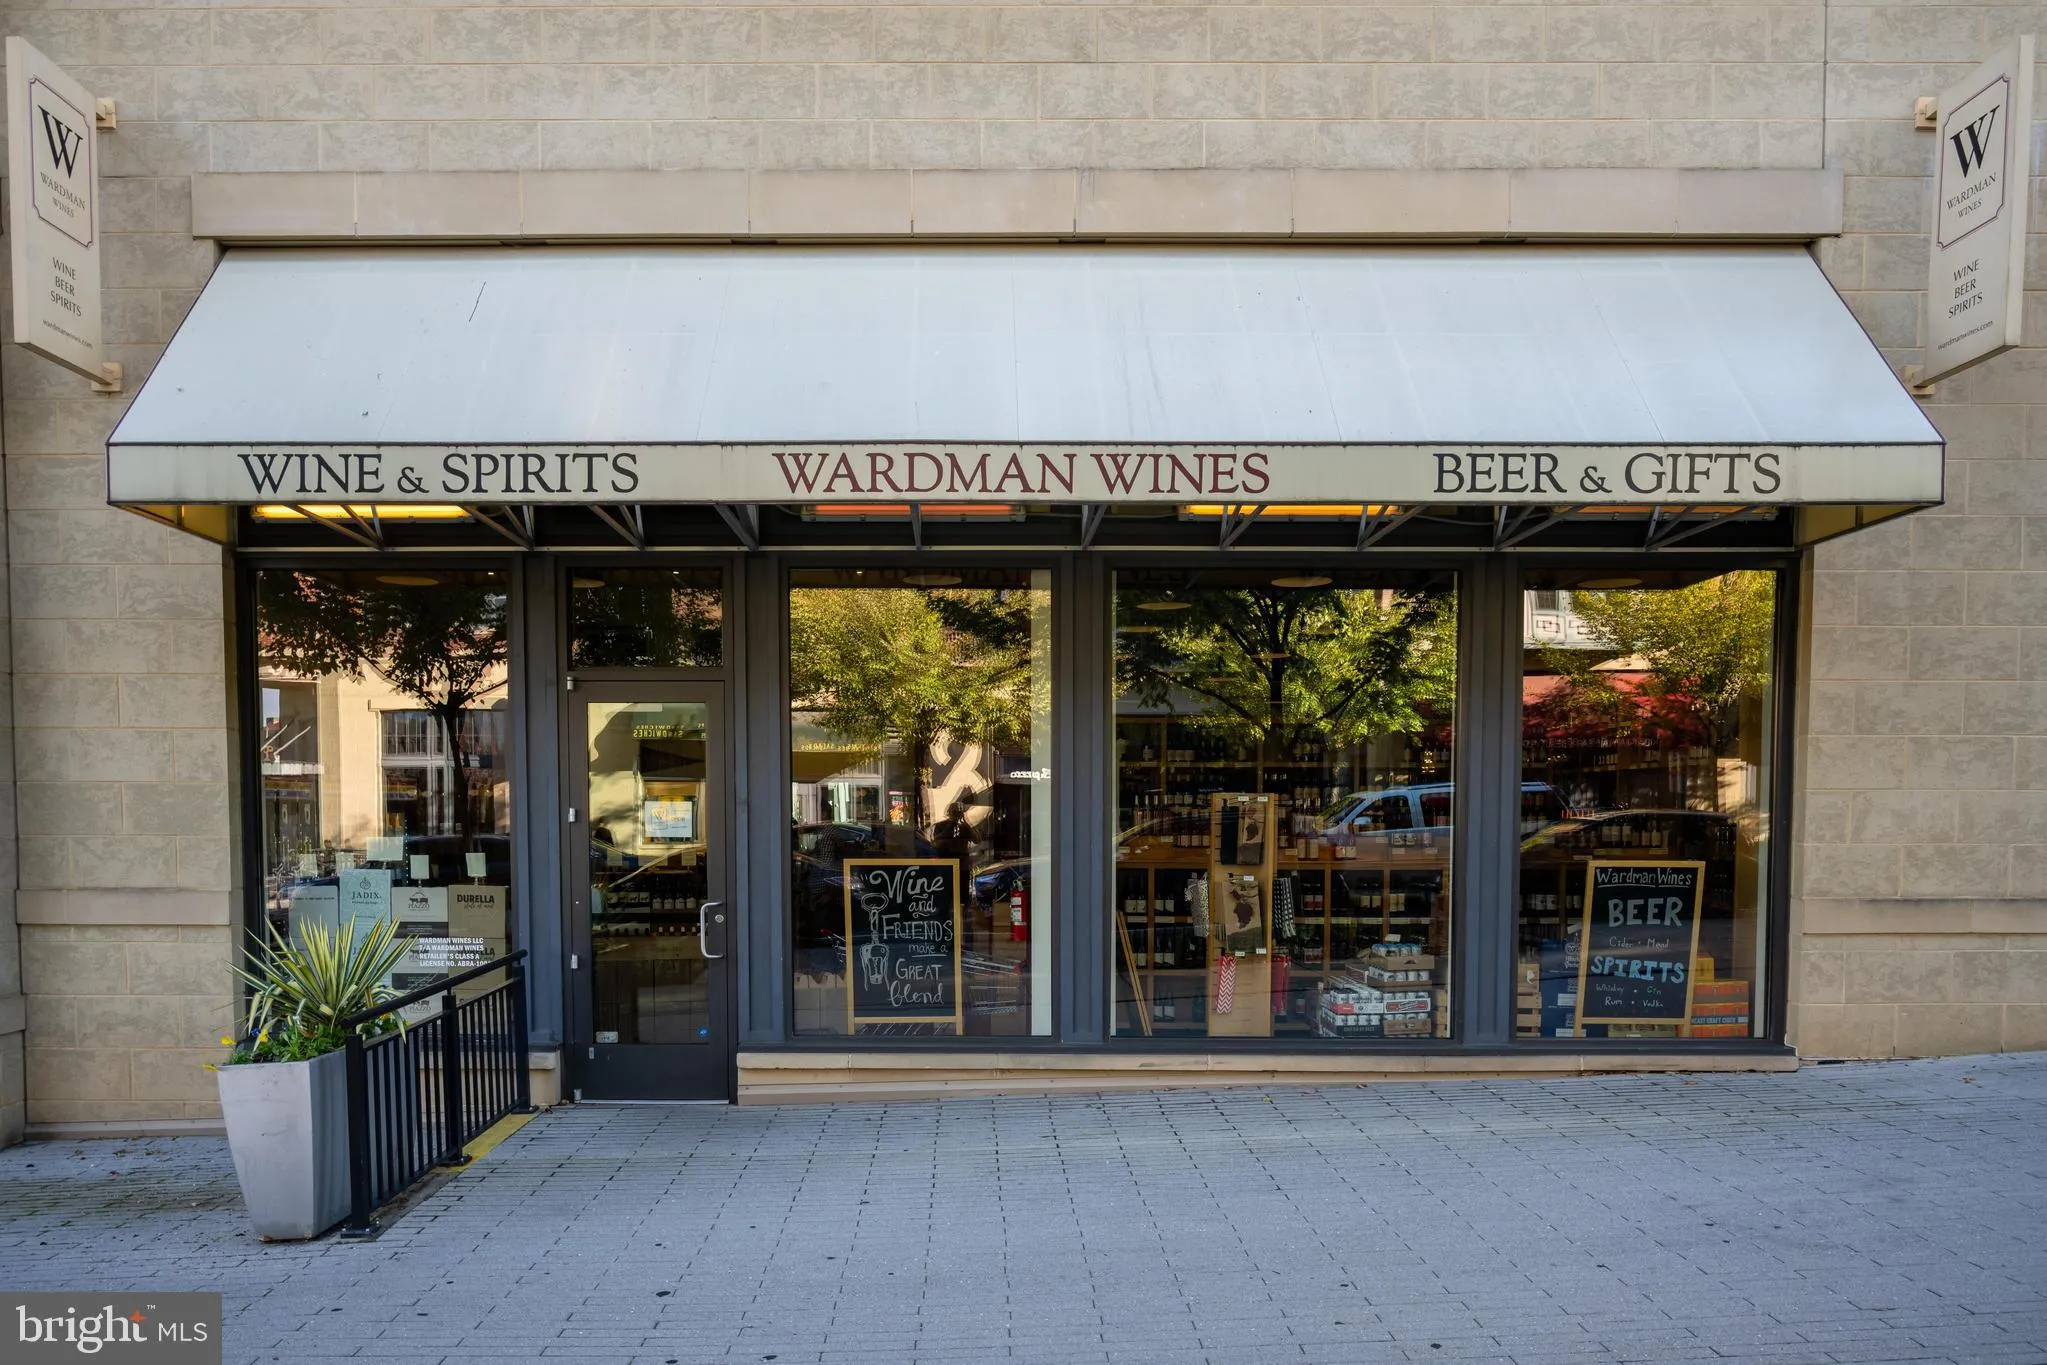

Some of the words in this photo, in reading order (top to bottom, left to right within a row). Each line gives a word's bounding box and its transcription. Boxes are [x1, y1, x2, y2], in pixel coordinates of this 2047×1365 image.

[38, 104, 83, 179] W
[1949, 104, 2000, 179] W
[39, 171, 85, 210] WARDMAN
[1946, 172, 1997, 210] WARDMAN
[52, 196, 74, 218] WINES
[1957, 199, 1982, 218] WINES
[52, 256, 76, 281] WINE
[1953, 258, 1980, 282] WINE
[55, 275, 75, 297] BEER
[1954, 278, 1977, 299] BEER
[50, 289, 82, 317] SPIRITS
[1948, 291, 1983, 319] SPIRITS
[1937, 320, 1993, 350] wardmanwines.com
[237, 453, 385, 495] WINE
[397, 466, 430, 494] &
[441, 452, 639, 494] SPIRITS
[772, 452, 1077, 494] WARDMAN
[1090, 452, 1270, 494] WINES
[1433, 452, 1568, 494] BEER
[1579, 465, 1613, 494] &
[1624, 452, 1781, 494] GIFTS
[869, 866, 945, 903] Wine
[1596, 868, 1656, 884] Wardman
[1657, 868, 1692, 886] Wines
[456, 894, 495, 904] DURELLA
[909, 895, 936, 913] and
[1608, 896, 1683, 927] BEER
[881, 913, 953, 941] FRIENDS
[909, 943, 935, 954] make
[940, 944, 948, 952] a
[1609, 936, 1633, 948] Cider
[896, 958, 943, 980] GREAT
[1590, 955, 1685, 984] SPIRITS
[890, 980, 944, 1007] blend
[1596, 984, 1624, 993] Whiskey
[1647, 985, 1661, 996] Gin
[1605, 996, 1622, 1006] Rum
[1643, 999, 1664, 1008] Vodka
